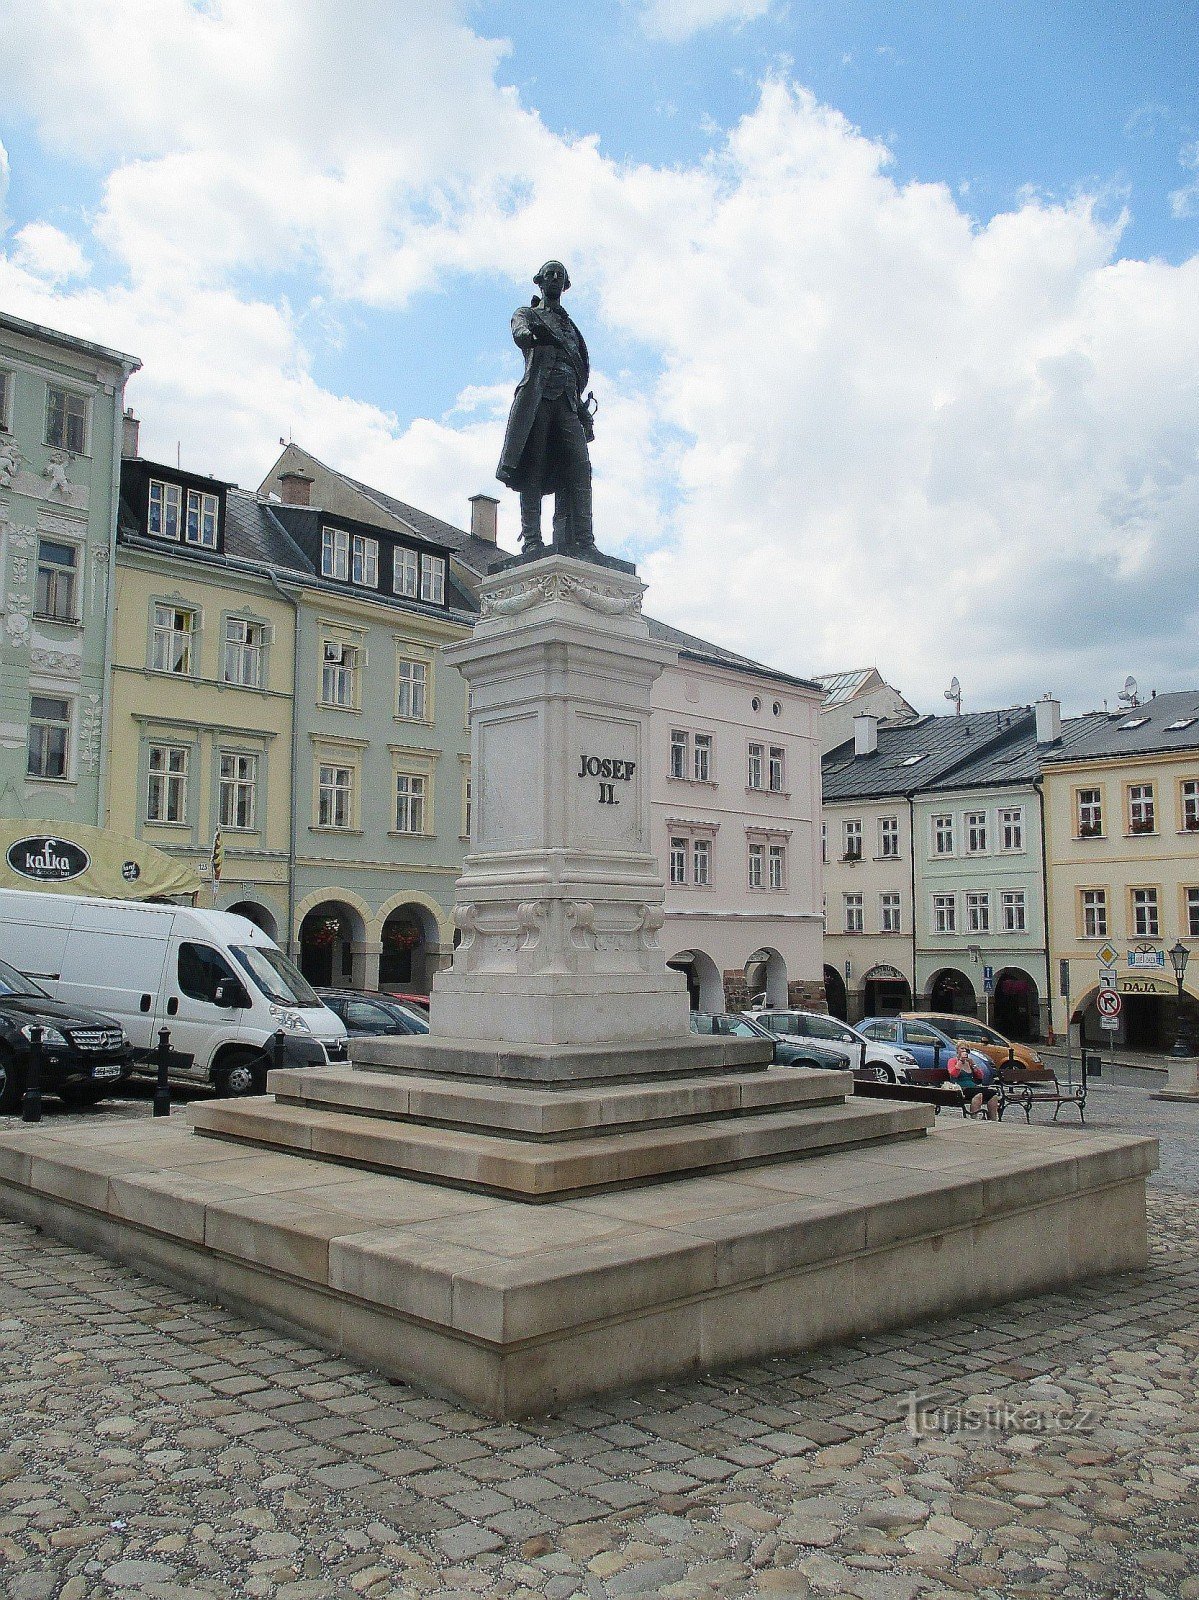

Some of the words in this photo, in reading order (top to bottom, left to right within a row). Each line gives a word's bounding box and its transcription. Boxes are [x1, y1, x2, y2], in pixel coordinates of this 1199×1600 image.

[578, 754, 636, 781] JOSEF
[598, 782, 620, 805] II.
[26, 840, 70, 869] kafka
[1122, 982, 1157, 993] DAJA
